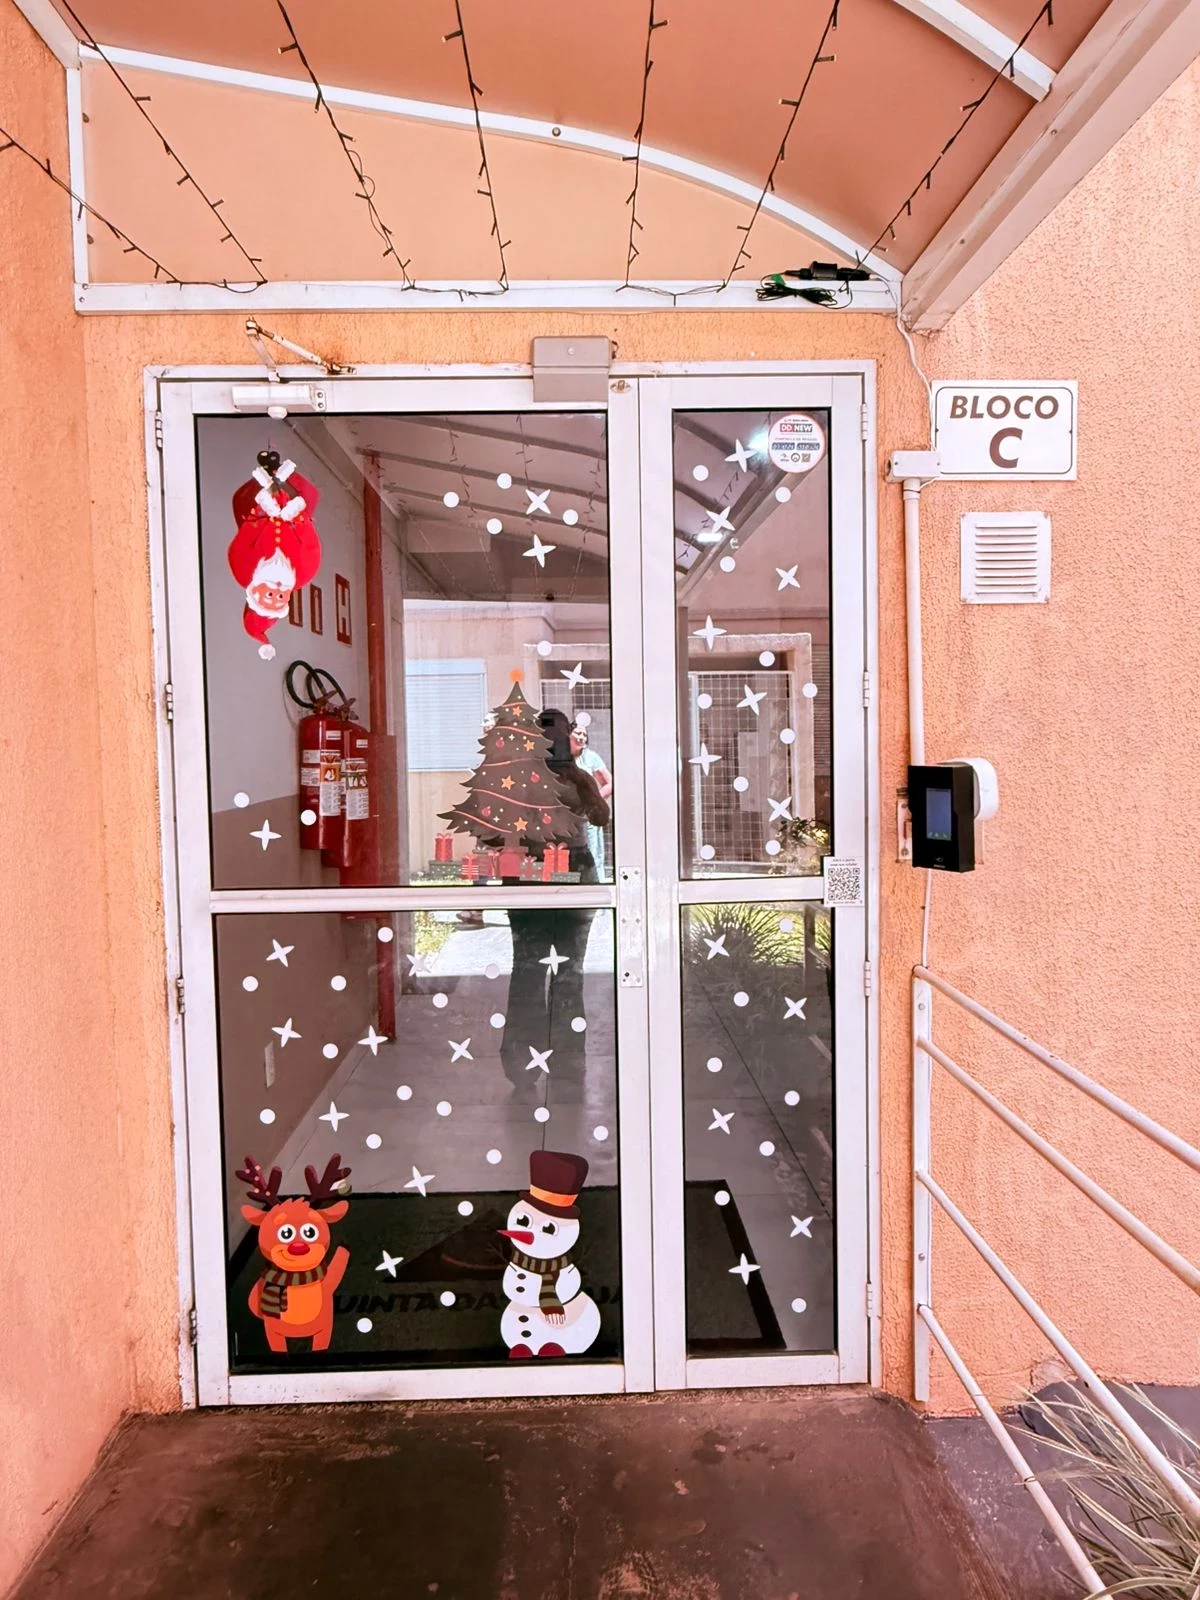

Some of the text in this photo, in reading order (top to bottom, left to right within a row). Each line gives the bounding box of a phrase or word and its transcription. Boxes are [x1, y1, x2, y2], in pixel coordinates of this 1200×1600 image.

[950, 395, 1059, 419] BLOCO
[794, 424, 812, 432] NEW
[989, 427, 1023, 469] C
[334, 1292, 509, 1315] UINTA DA
